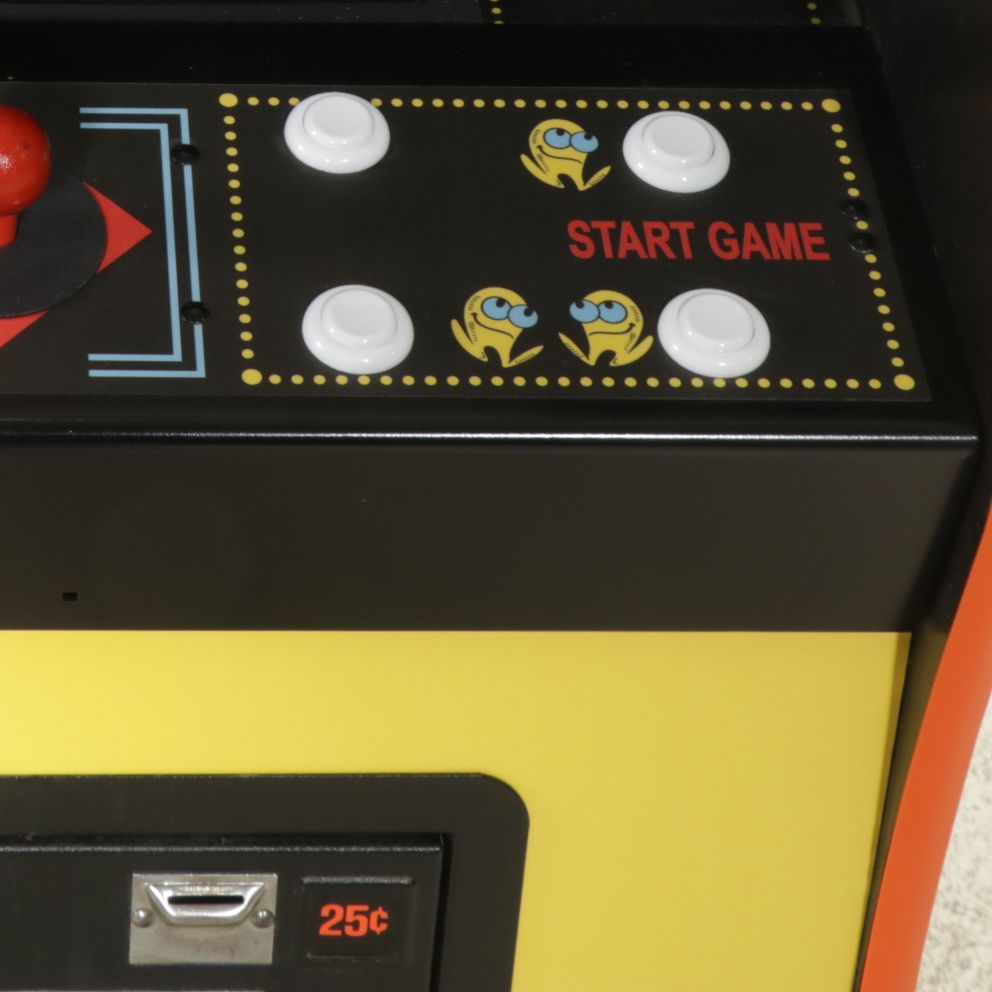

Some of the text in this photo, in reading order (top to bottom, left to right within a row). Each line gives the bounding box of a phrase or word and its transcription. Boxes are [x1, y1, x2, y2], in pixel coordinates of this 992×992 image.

[567, 220, 831, 260] START GAME
[319, 904, 389, 937] 25¢
